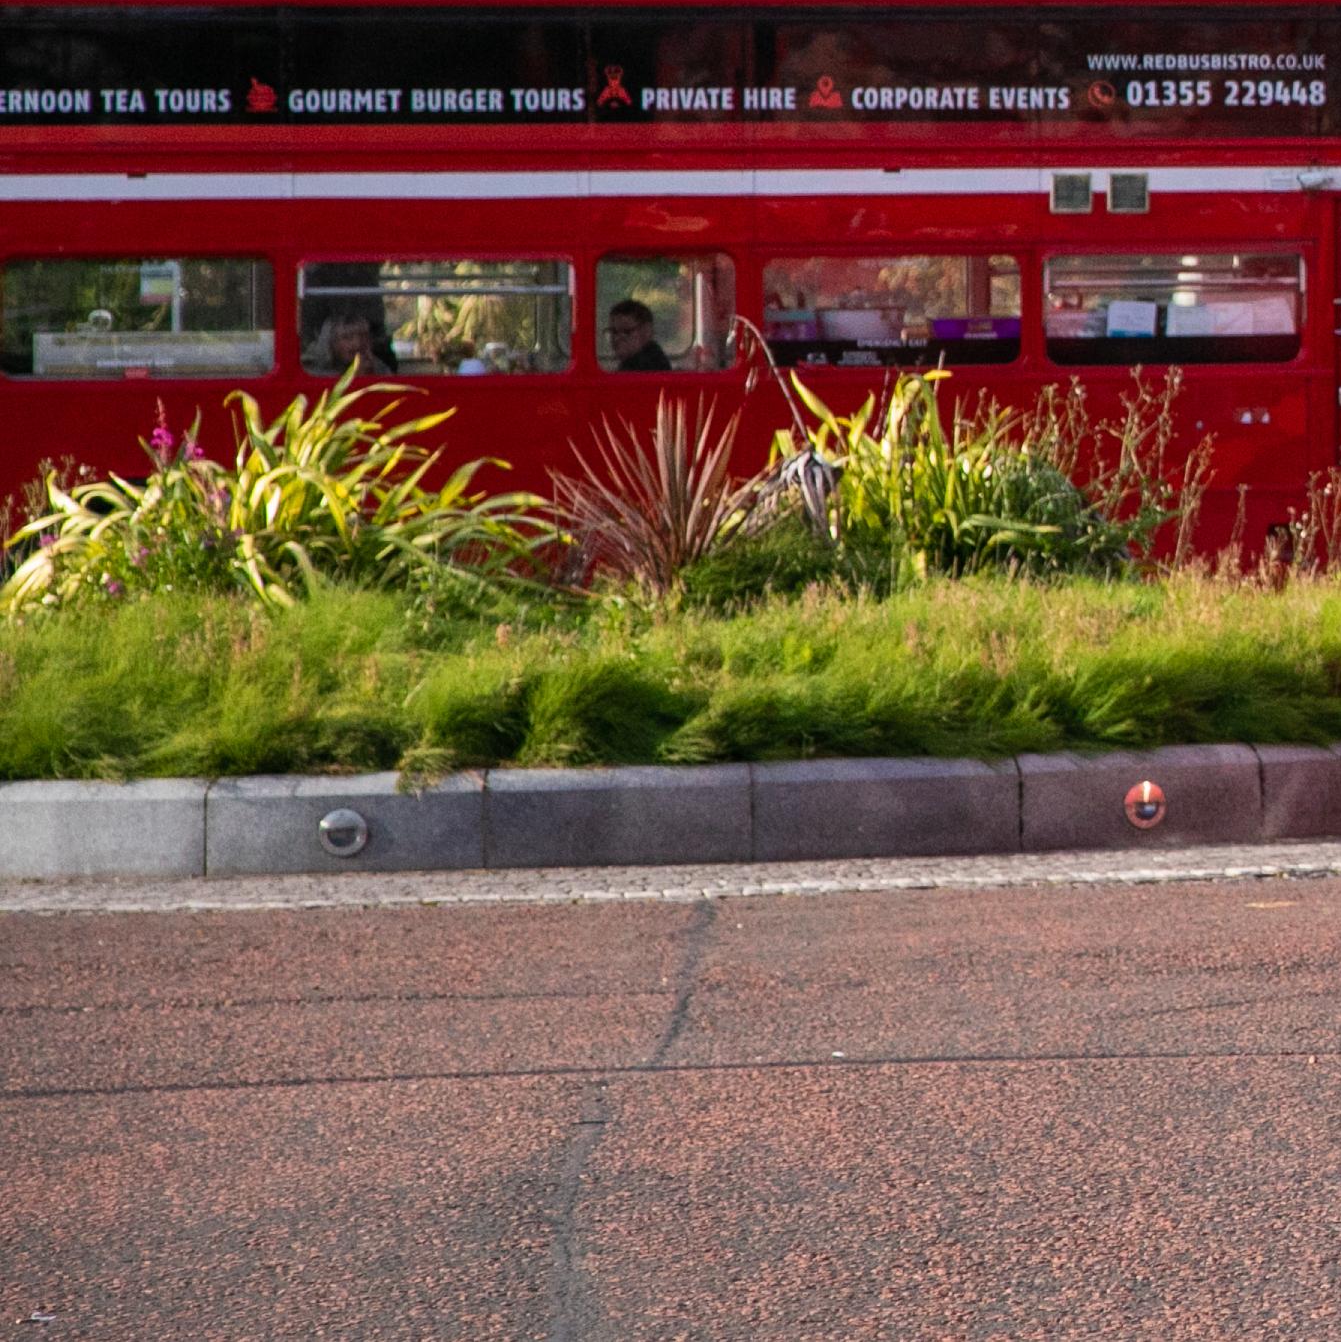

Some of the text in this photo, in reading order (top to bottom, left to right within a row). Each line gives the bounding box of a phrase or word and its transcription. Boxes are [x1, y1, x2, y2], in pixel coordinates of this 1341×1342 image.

[1086, 53, 1326, 72] WWW.REDBUSBISTRO.CO.UK
[99, 88, 146, 113] TEA
[154, 88, 232, 113] TOURS
[287, 87, 586, 113] GOURMET BURGER TOURS
[641, 86, 797, 112] PRIVATE HIRE
[850, 85, 1071, 111] CORPORATE EVENTS
[1126, 79, 1327, 108] 01355 229448
